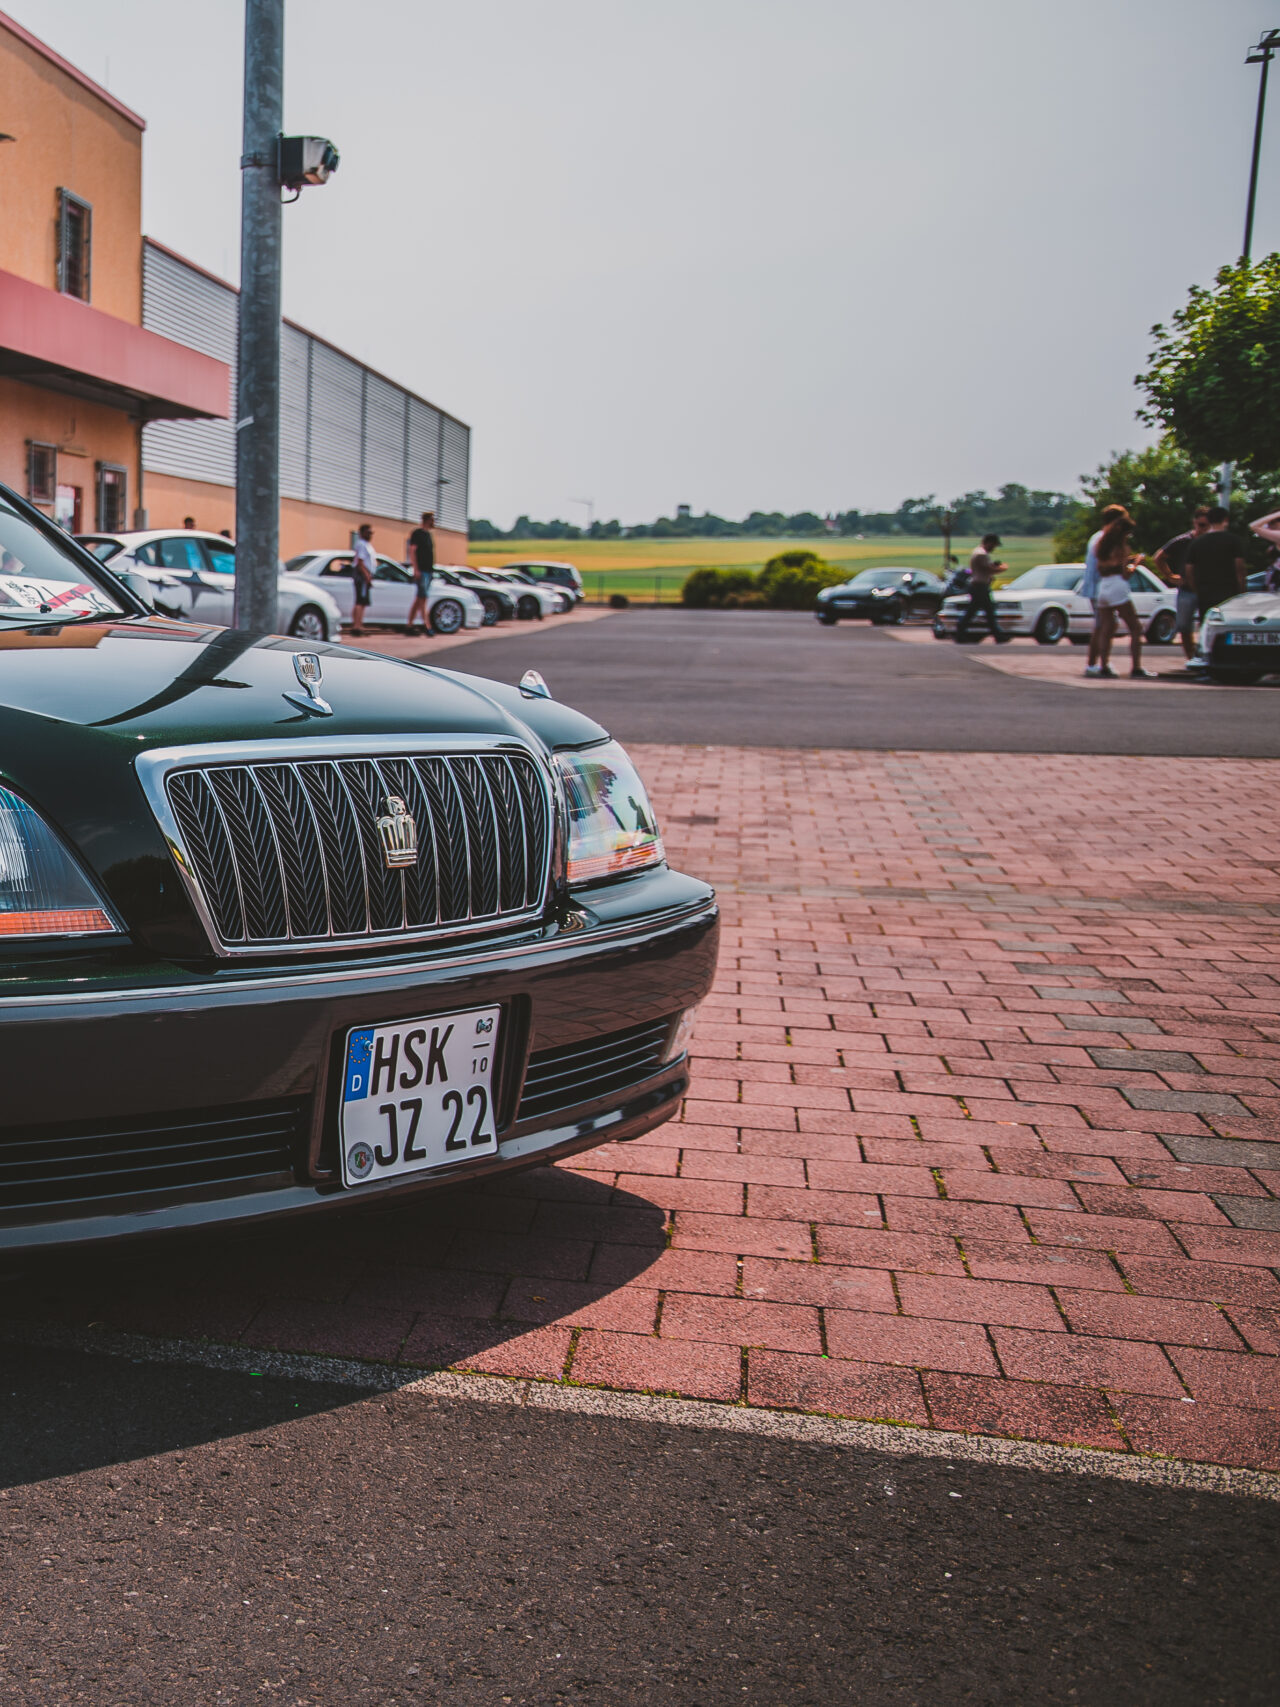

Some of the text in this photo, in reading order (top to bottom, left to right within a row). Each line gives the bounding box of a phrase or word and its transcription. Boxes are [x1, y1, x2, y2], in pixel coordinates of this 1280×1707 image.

[371, 1023, 455, 1096] HSK
[472, 1056, 488, 1074] 10
[351, 1074, 363, 1092] D
[374, 1098, 427, 1167] JZ
[442, 1085, 492, 1152] 22
